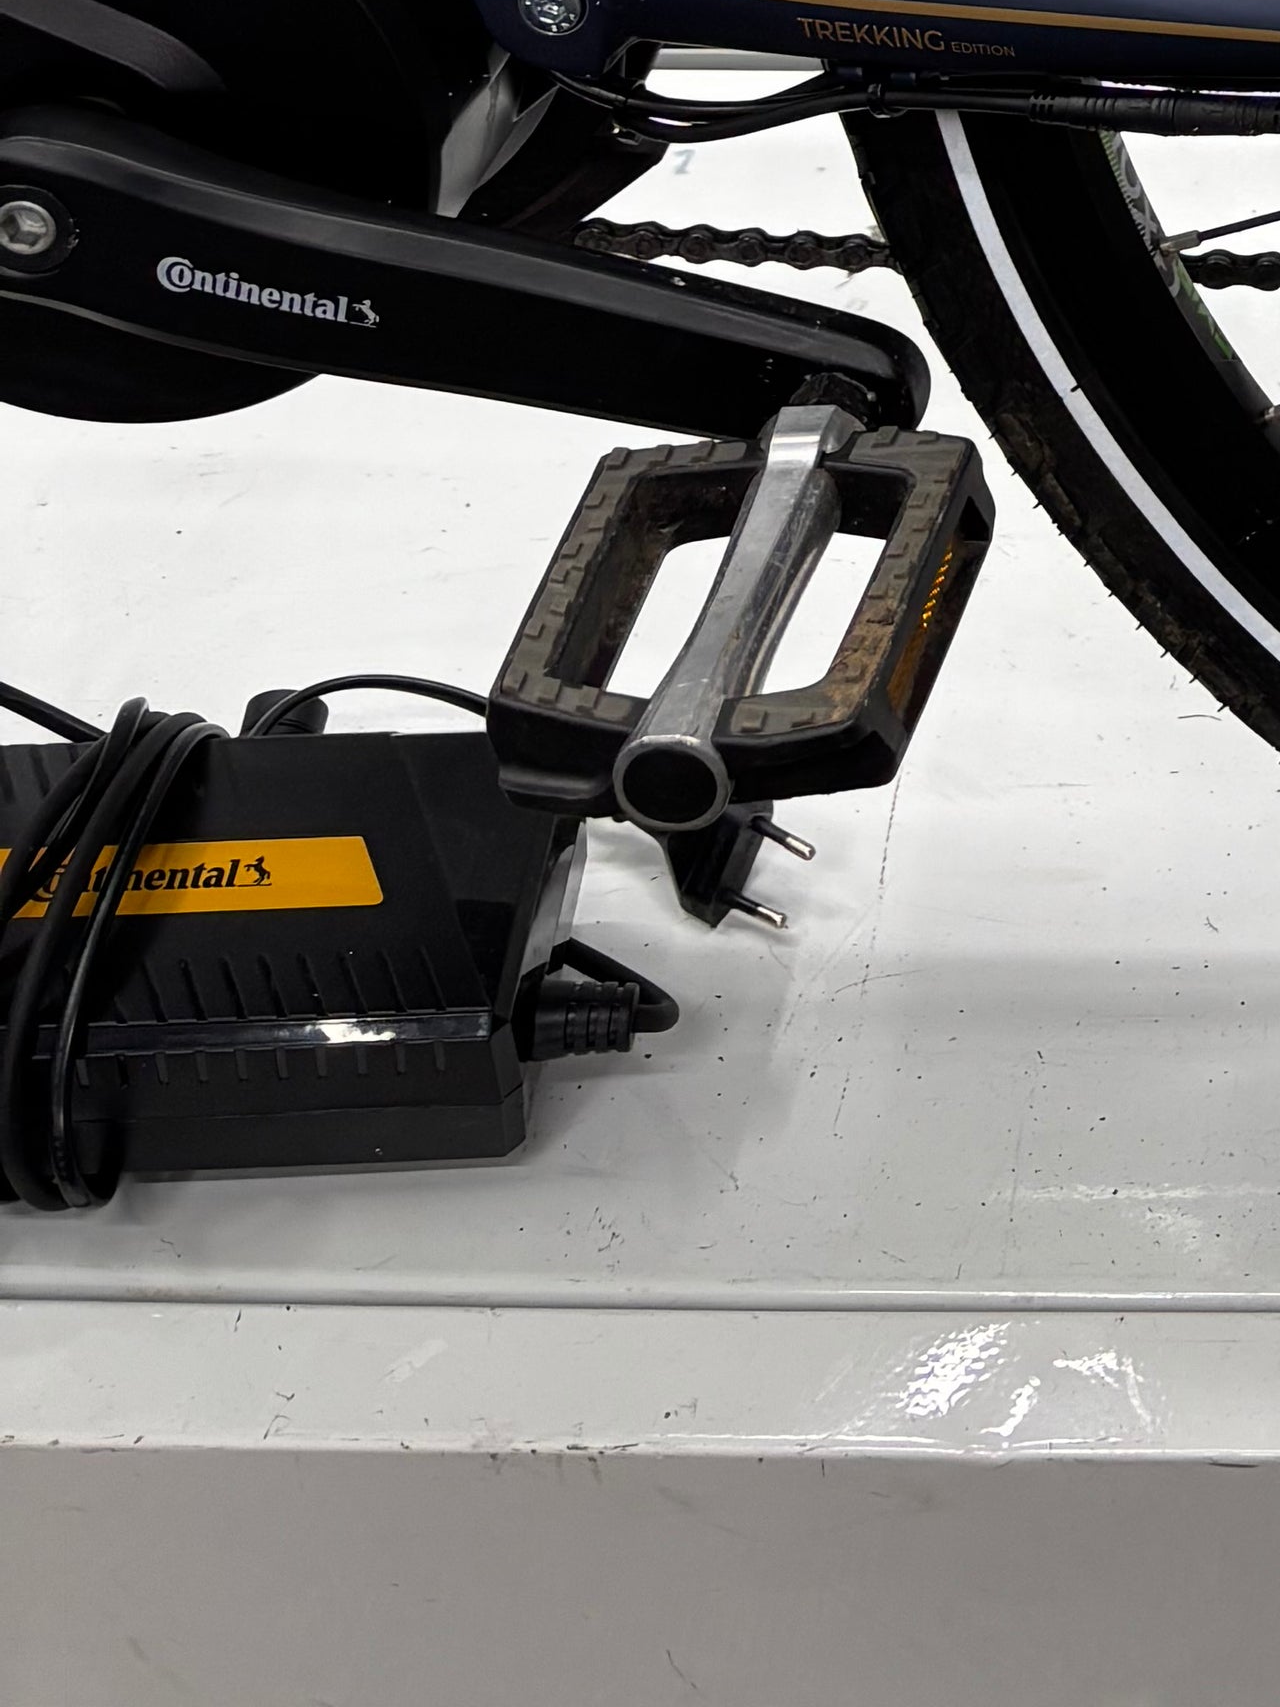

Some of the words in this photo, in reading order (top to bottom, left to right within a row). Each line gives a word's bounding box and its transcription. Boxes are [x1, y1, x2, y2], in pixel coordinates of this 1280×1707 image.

[796, 17, 946, 51] TREKKING
[951, 40, 1016, 58] EDITION
[156, 256, 348, 323] Continental
